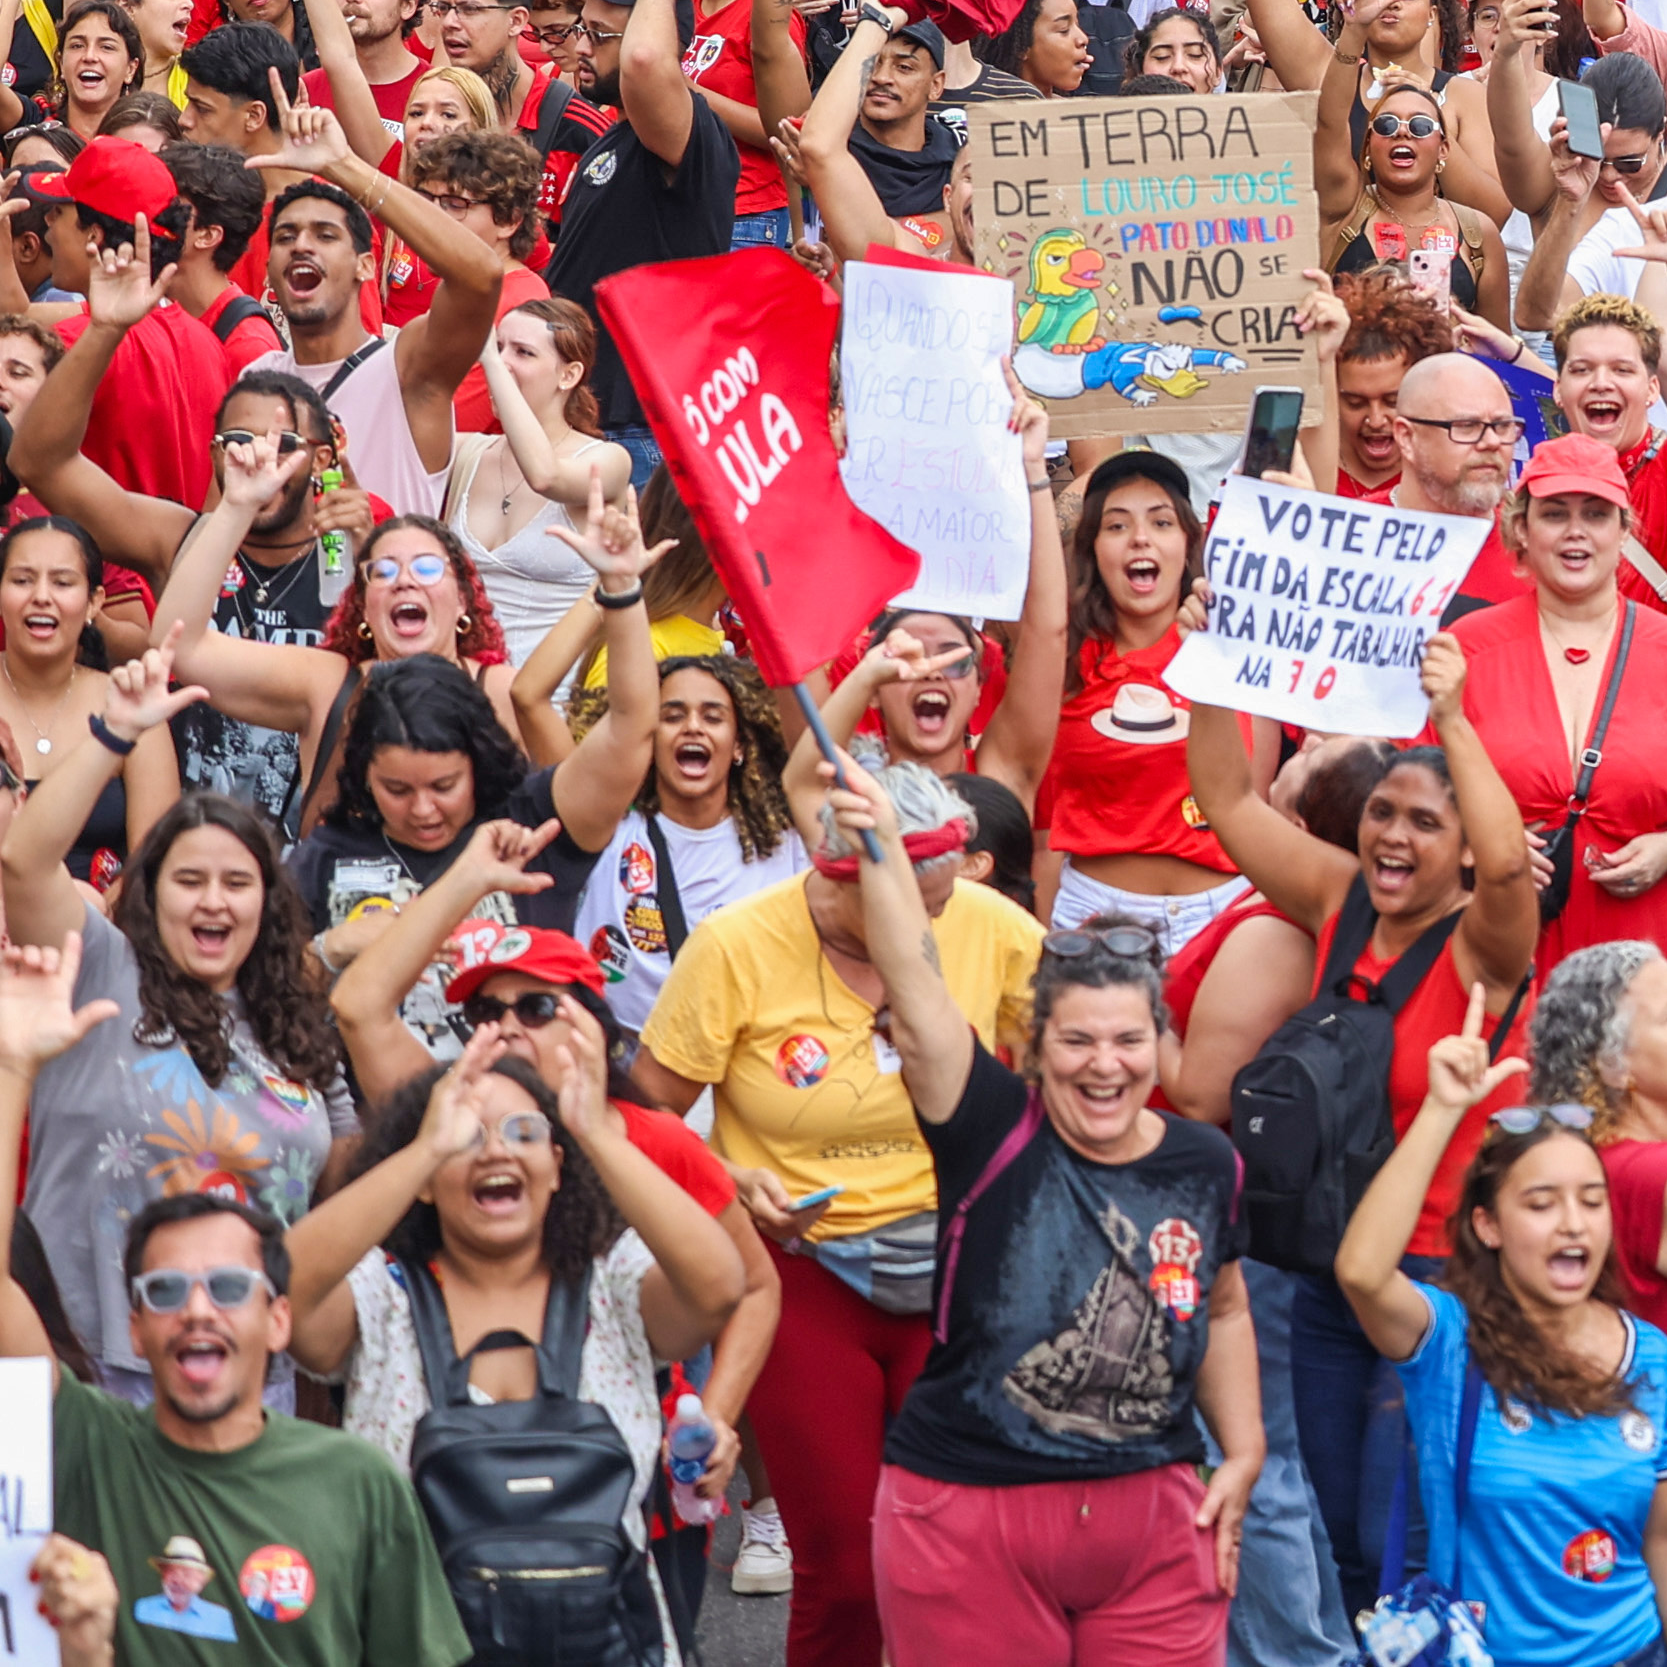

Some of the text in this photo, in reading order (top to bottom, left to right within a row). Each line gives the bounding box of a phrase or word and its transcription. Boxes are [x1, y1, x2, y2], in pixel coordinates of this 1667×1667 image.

[990, 106, 1260, 170] EM TERRA
[992, 160, 1300, 219] DE LOURO JOSÉ
[1120, 221, 1190, 253] PATO
[1130, 247, 1289, 307] NÃO SE
[1210, 305, 1305, 347] CRIA
[699, 344, 761, 427] COM
[715, 391, 804, 525] ULA
[911, 504, 1012, 544] MAIOR
[1257, 494, 1448, 564] VOTE PELO
[1207, 536, 1413, 618] FIM DA ESCALA
[1264, 605, 1325, 655] NÃO
[1234, 653, 1273, 690] NA
